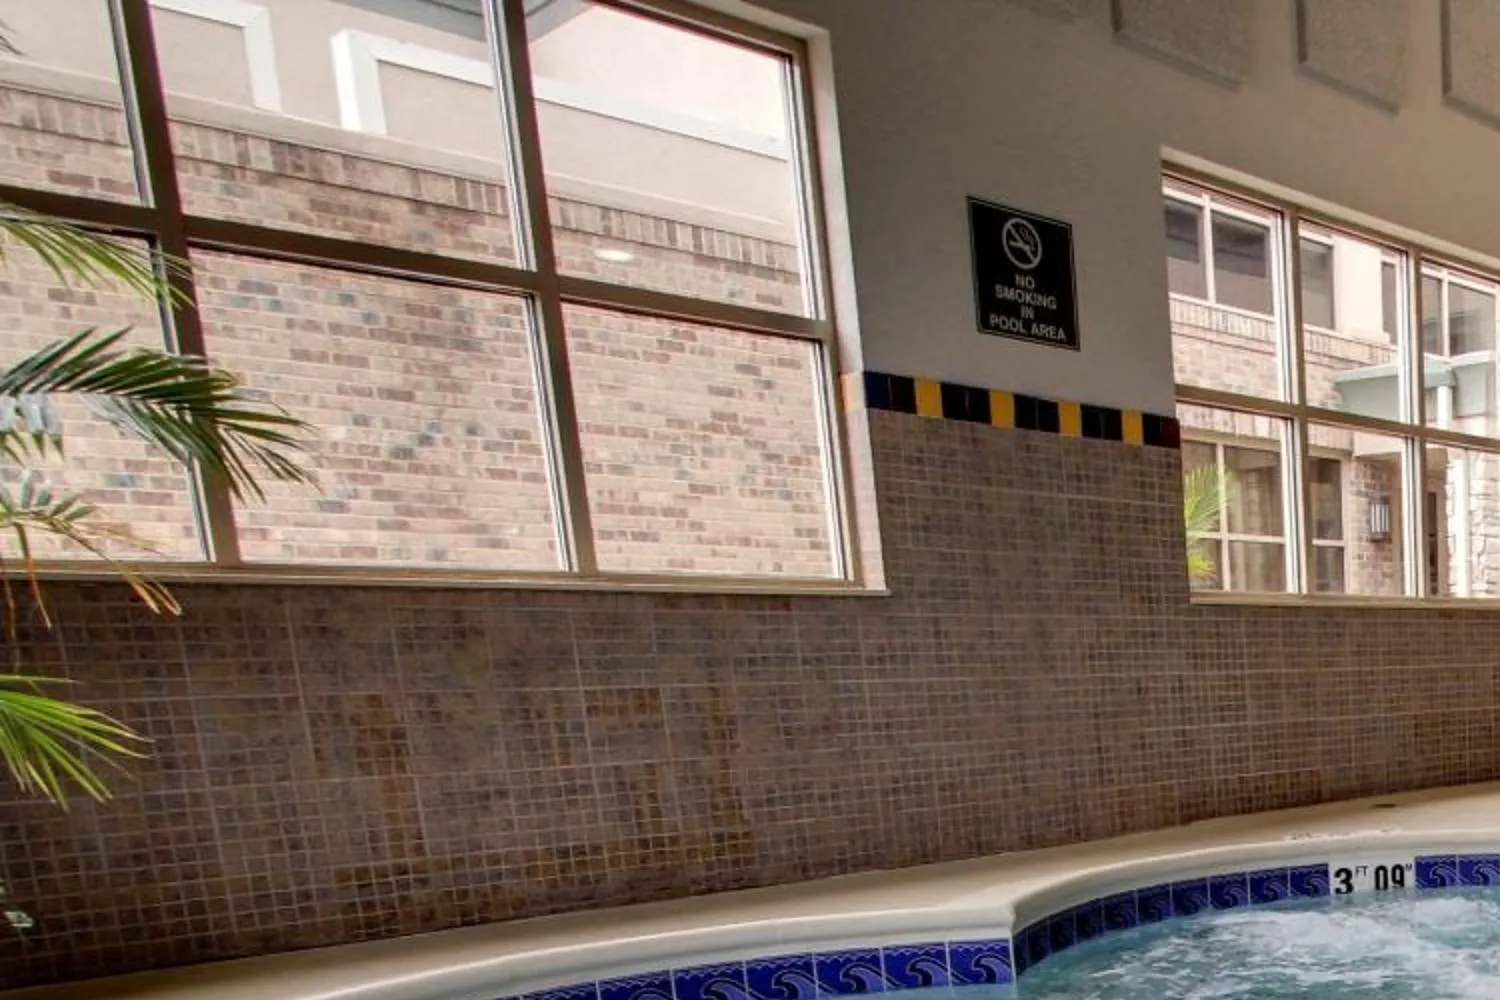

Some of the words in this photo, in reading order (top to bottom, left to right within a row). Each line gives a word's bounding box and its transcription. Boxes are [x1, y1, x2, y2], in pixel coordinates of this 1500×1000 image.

[1015, 273, 1035, 290] NO
[995, 284, 1058, 310] SMOKING
[1020, 304, 1034, 320] IN
[990, 313, 1028, 335] POOL
[1031, 322, 1067, 342] AREA
